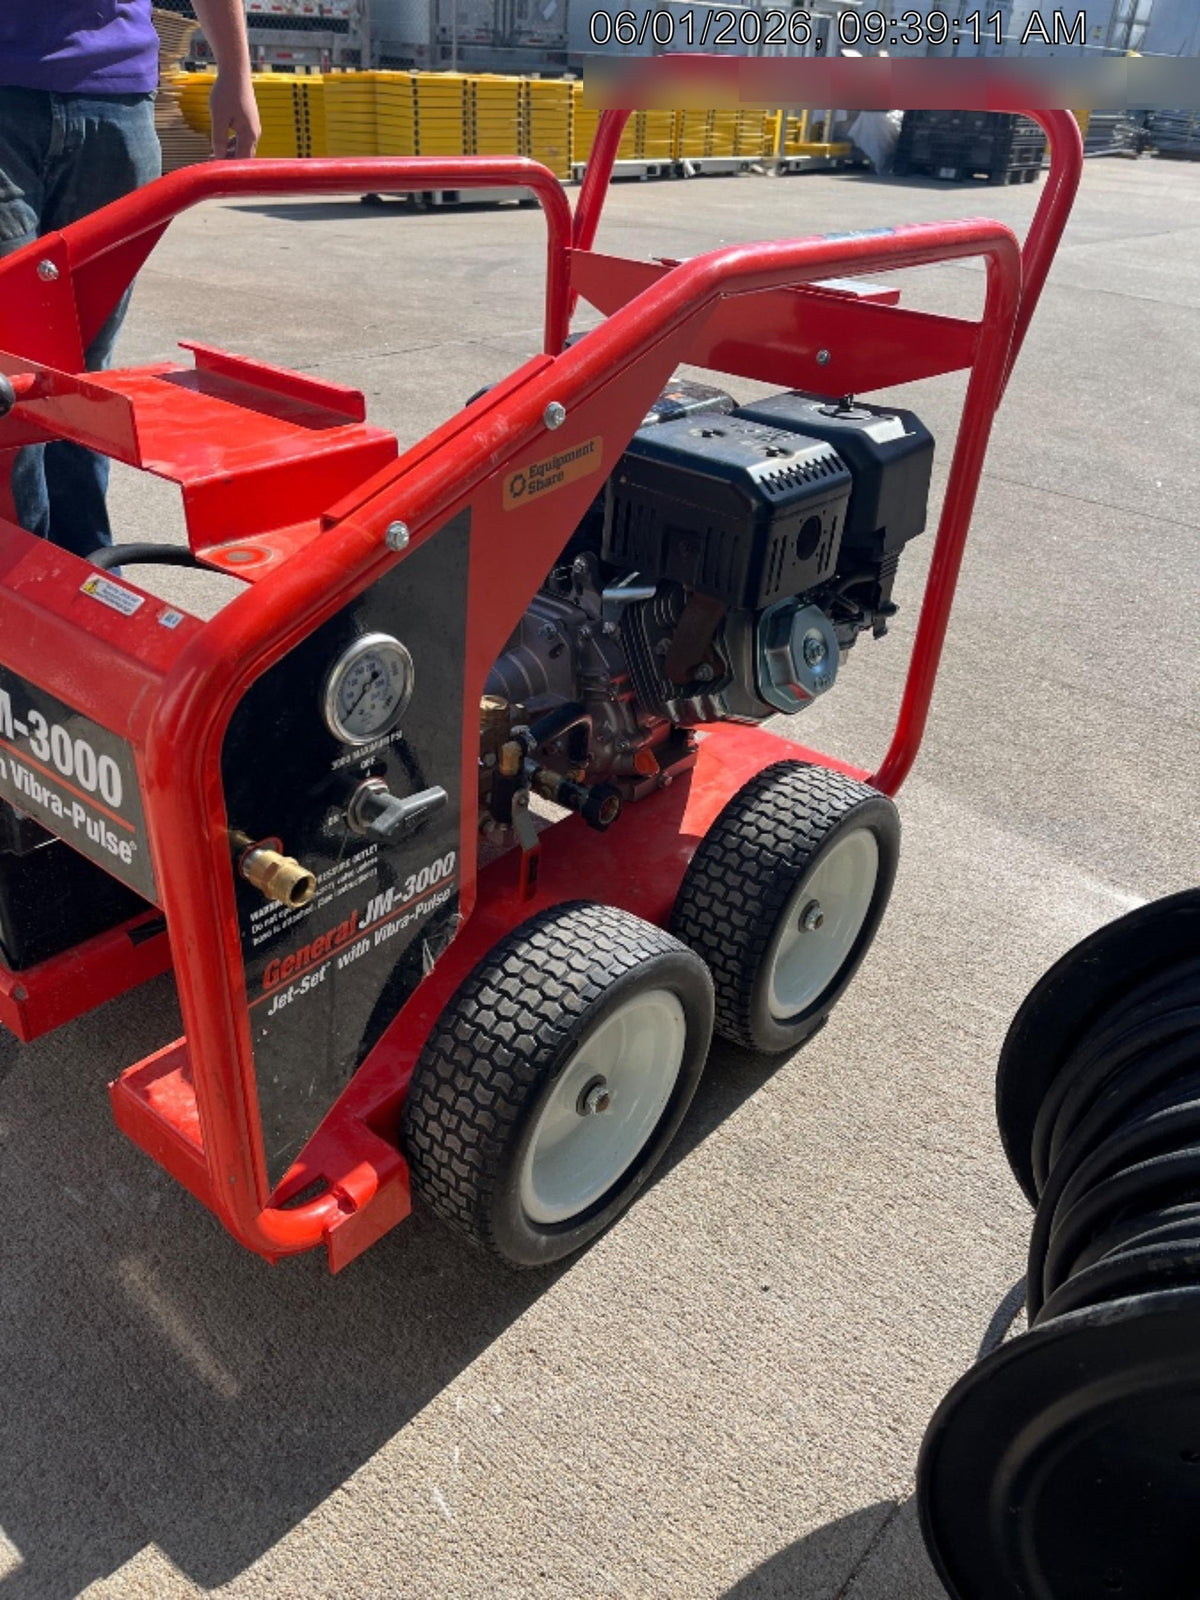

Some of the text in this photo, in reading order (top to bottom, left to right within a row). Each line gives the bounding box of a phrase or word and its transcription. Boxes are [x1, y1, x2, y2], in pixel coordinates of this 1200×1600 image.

[528, 440, 595, 478] Equipment
[528, 471, 564, 495] Share
[390, 730, 403, 742] PSI
[360, 755, 377, 770] OFF
[352, 843, 378, 864] OUTLET
[252, 923, 264, 934] Do
[264, 913, 278, 927] not
[262, 851, 456, 990] General JM-3000
[338, 938, 370, 970] with
